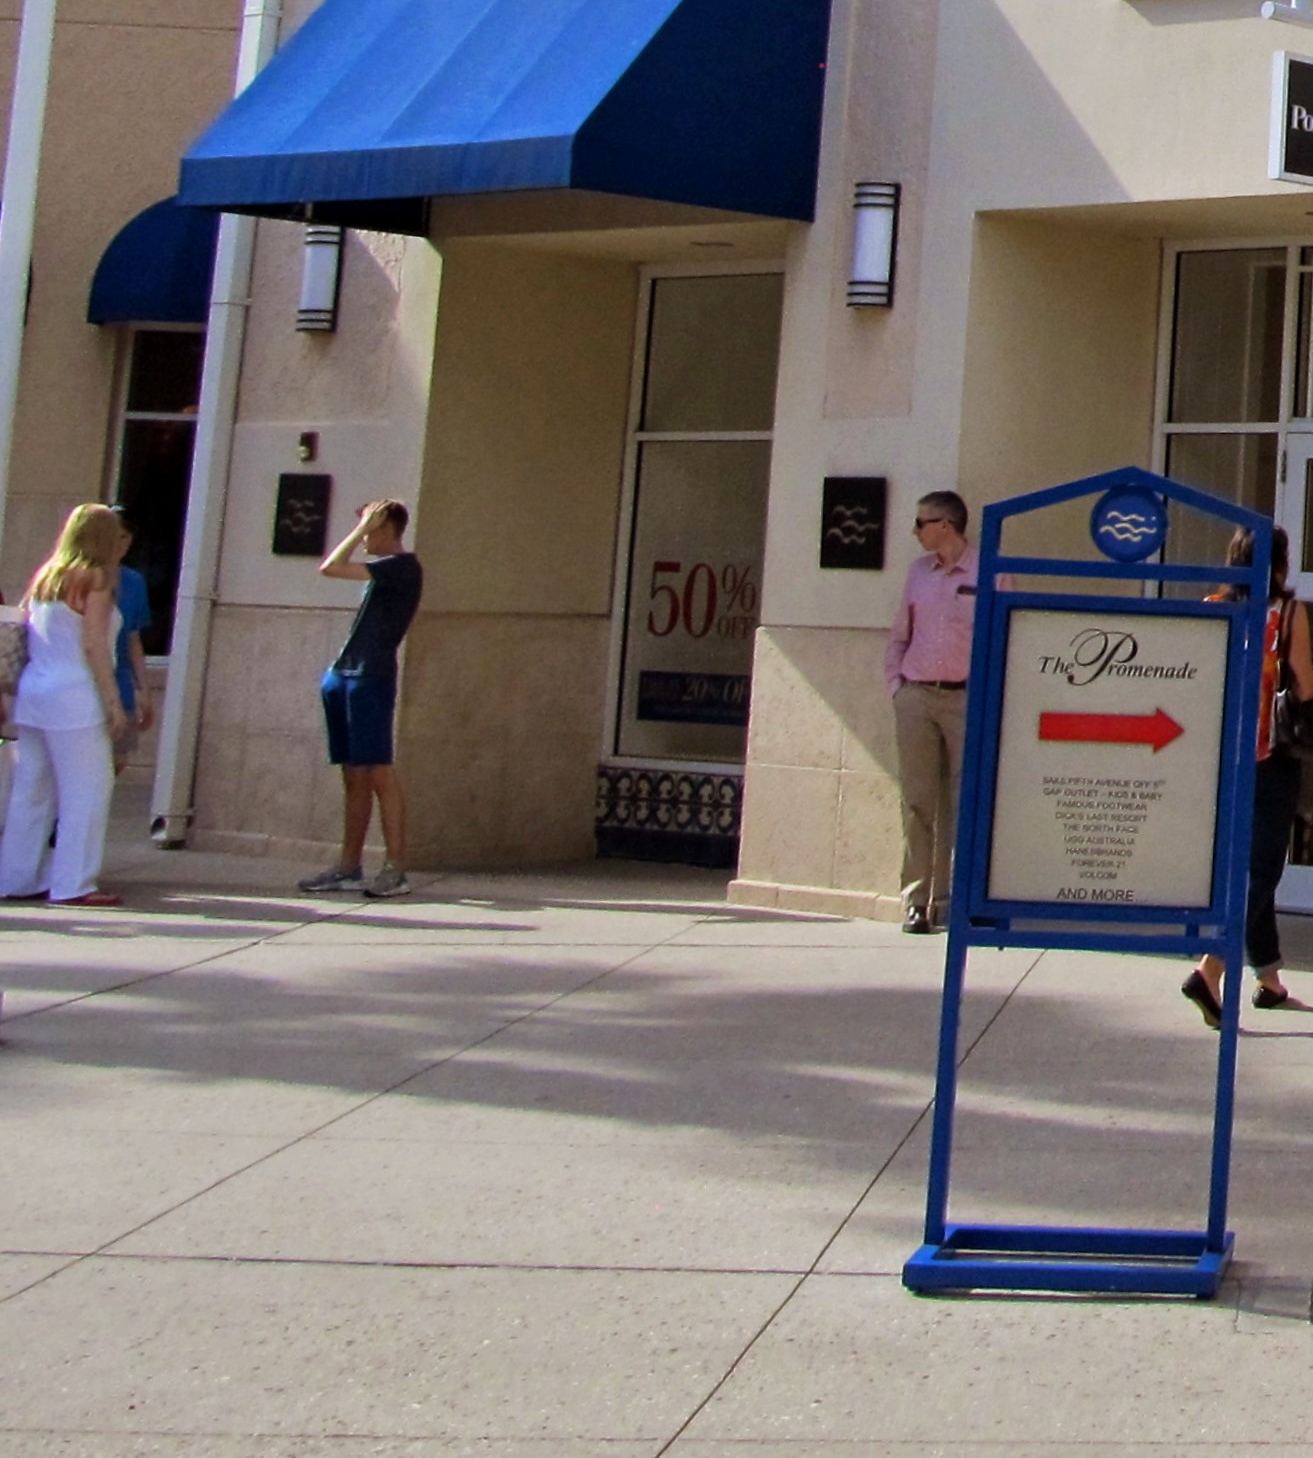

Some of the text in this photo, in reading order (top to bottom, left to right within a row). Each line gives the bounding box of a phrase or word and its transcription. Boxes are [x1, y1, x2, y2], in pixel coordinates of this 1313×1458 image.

[648, 561, 756, 639] 50%
[1038, 627, 1198, 686] The Promenade
[1096, 801, 1148, 811] FOOTWEAR
[1110, 813, 1147, 823] RESORT
[1063, 822, 1080, 831] THE
[1057, 887, 1088, 900] AND
